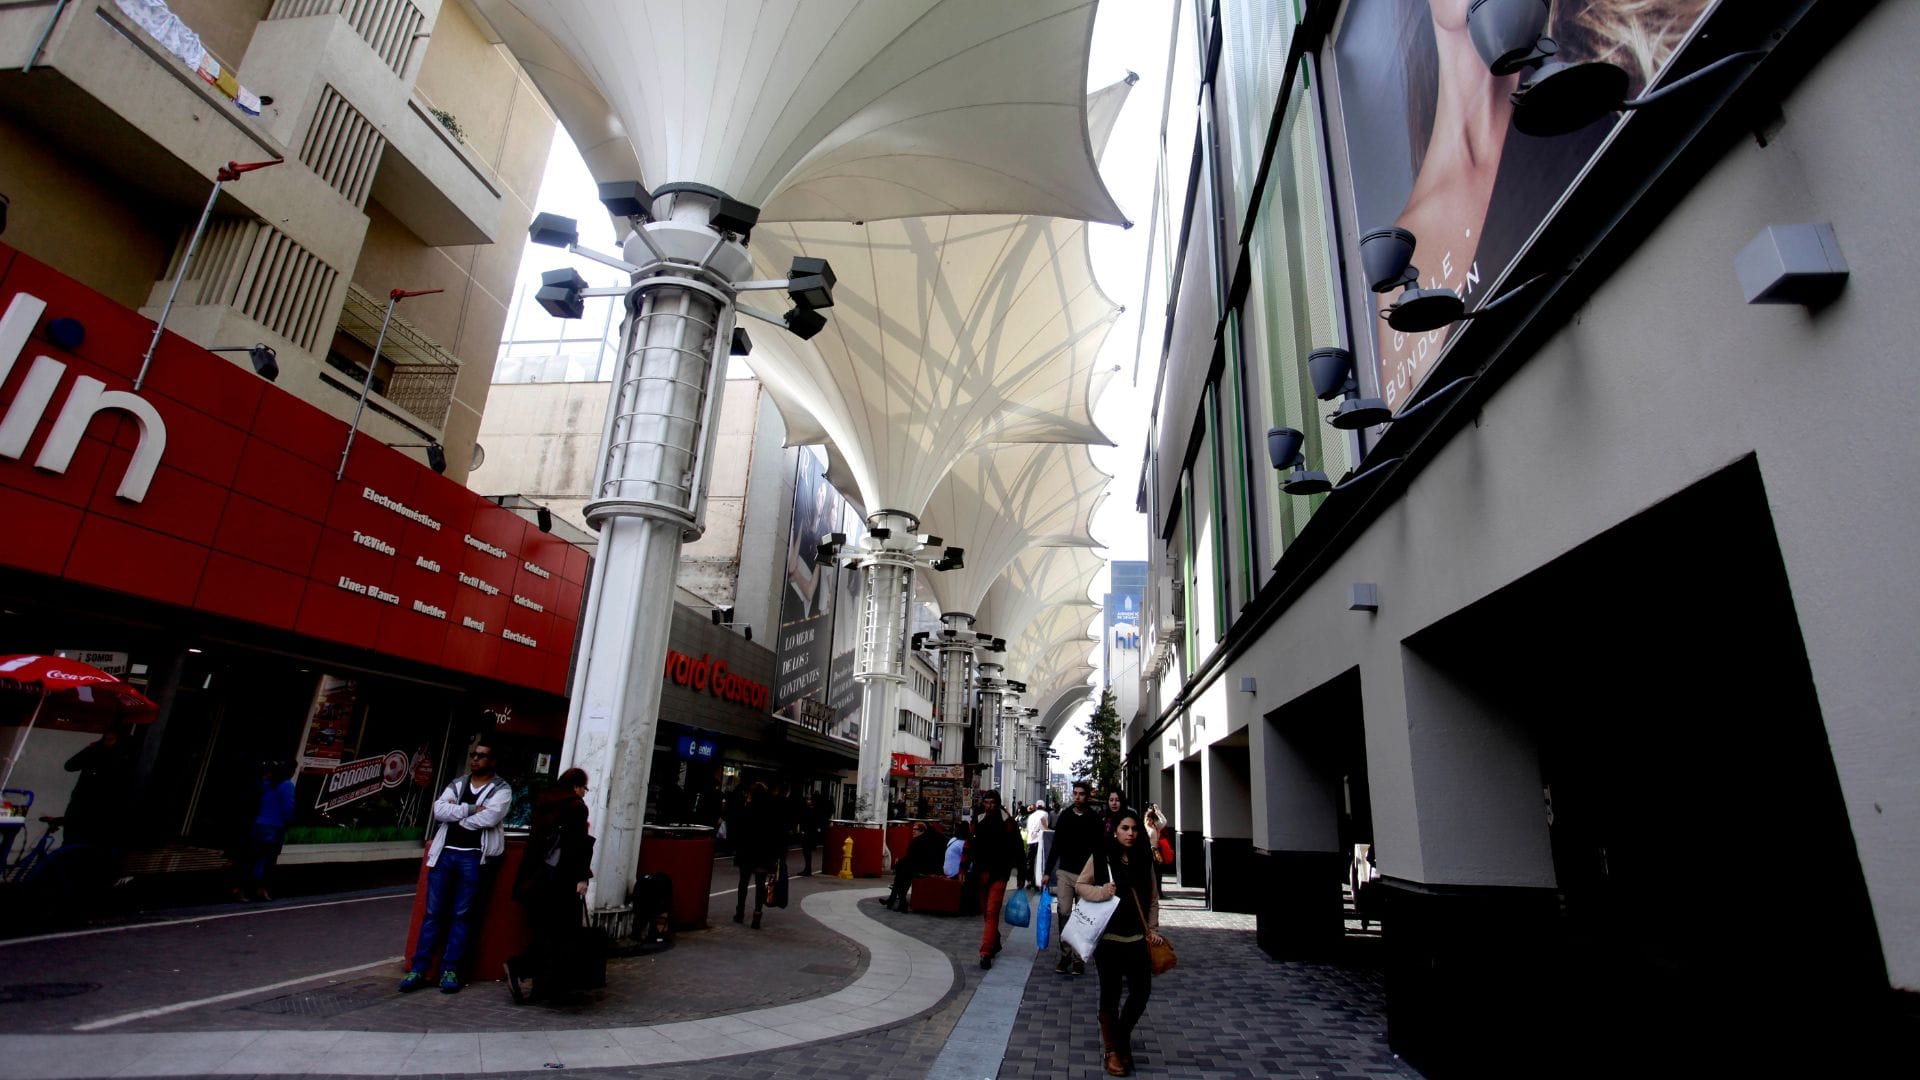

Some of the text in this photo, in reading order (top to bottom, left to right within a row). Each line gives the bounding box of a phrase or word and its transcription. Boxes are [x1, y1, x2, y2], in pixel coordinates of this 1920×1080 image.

[363, 487, 441, 531] Electrodomésticos
[353, 531, 396, 556] Tv&Video
[416, 556, 440, 573] Audio
[367, 585, 400, 605] Blanca
[413, 600, 447, 619] Muebles
[785, 634, 796, 652] LO
[85, 653, 113, 662] SOMOS
[782, 660, 793, 675] DE
